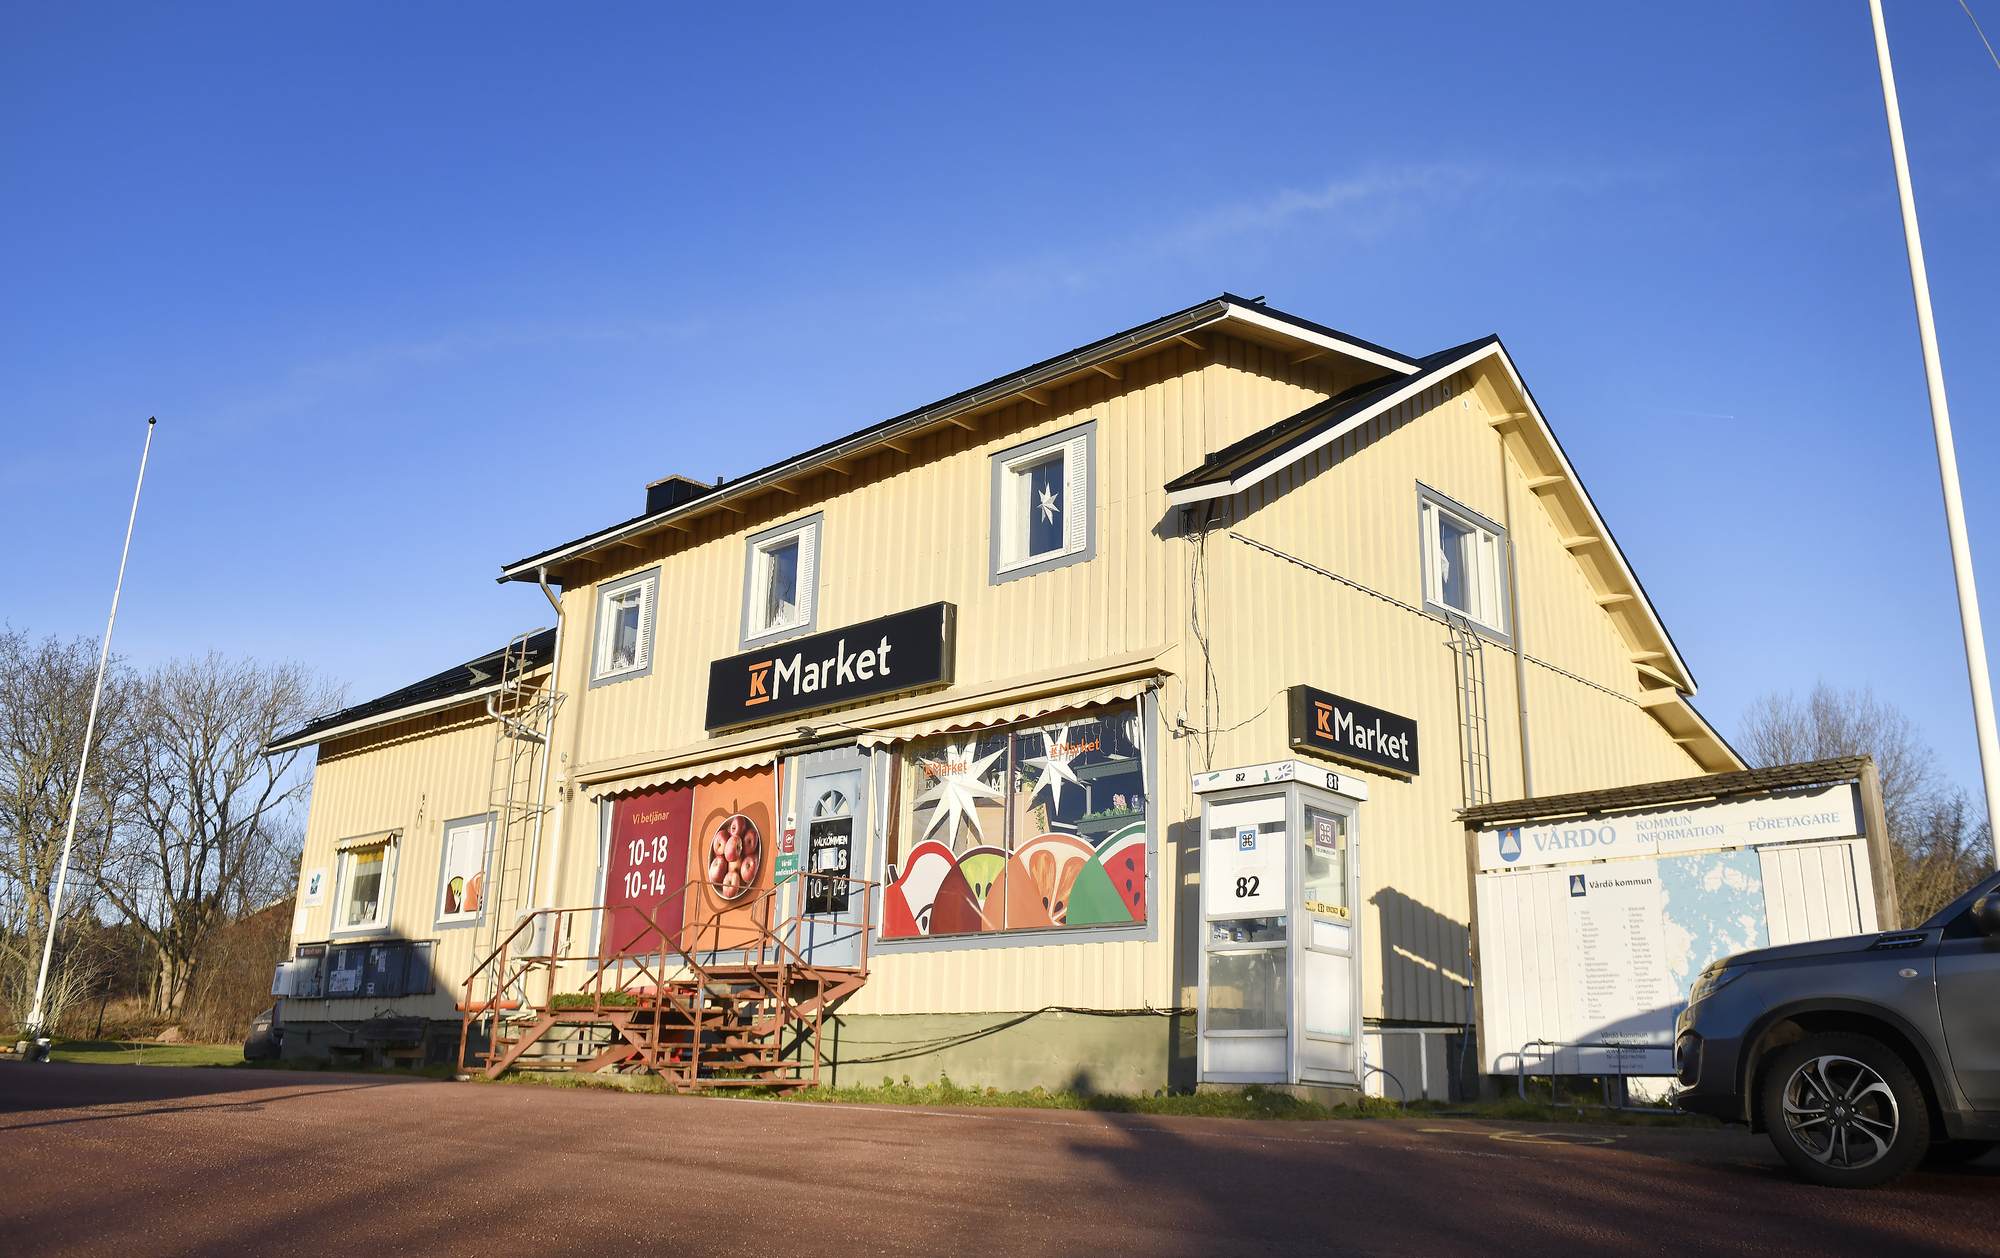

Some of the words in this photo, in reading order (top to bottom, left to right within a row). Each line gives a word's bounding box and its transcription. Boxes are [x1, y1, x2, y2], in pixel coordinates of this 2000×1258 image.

[772, 635, 891, 700] Market
[1333, 707, 1410, 762] Market
[1059, 737, 1101, 755] Market
[932, 760, 968, 776] Market
[1235, 772, 1246, 782] 82
[1327, 773, 1339, 790] 81
[632, 814, 641, 825] Vi
[641, 811, 670, 825] betjänar
[1635, 815, 1693, 831] KOMMUN
[1748, 812, 1841, 832] FÖRETAGARE
[1533, 820, 1617, 852] VÅRDÖ
[1636, 824, 1725, 844] INFORMATION
[628, 835, 668, 866] 10-18
[624, 868, 666, 899] 10-14
[1235, 875, 1260, 898] 82
[1589, 877, 1613, 890] Vårdö
[1615, 877, 1652, 888] kommun
[1600, 1031, 1619, 1039] Vårdö
